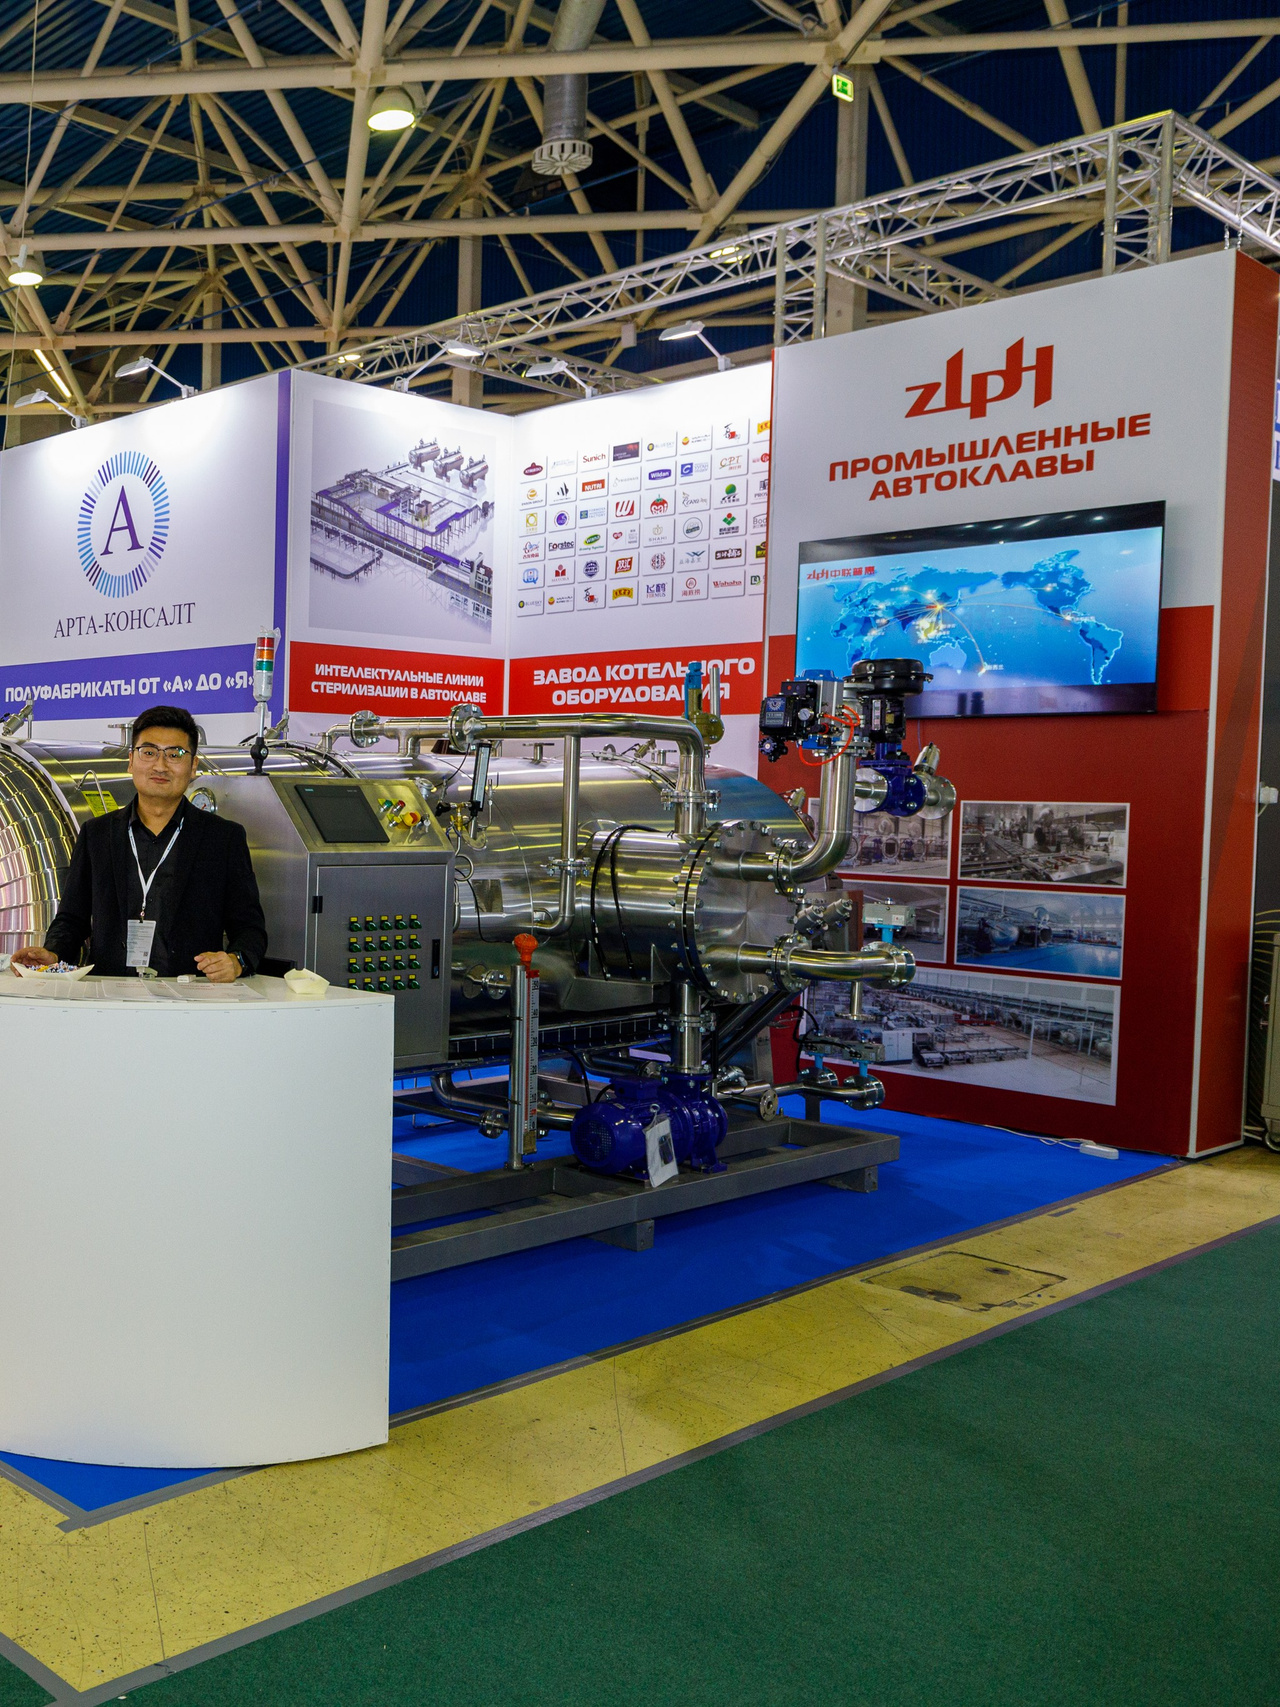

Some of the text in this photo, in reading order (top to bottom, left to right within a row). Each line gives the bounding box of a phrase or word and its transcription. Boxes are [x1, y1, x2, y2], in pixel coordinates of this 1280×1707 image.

[829, 413, 1152, 482] ПРОМЫШЛЕННЫЕ
[869, 449, 1095, 501] АВТОКЛАВЫ
[54, 602, 196, 638] АРТА-КОНСАЛТ
[5, 679, 135, 703] ПОЛУФАБРИКАТЫ
[138, 677, 161, 694] ОТ
[163, 675, 192, 692] «А»
[196, 672, 222, 691] ДО
[315, 663, 484, 687] ИНТЕЛЛЕКТУАЛЬНЫЕ ЛИНИИ
[533, 665, 602, 686] ЗАВОД
[311, 681, 487, 704] СТЕРИЛИЗАЦИИ В АВТОКЛАВЕ
